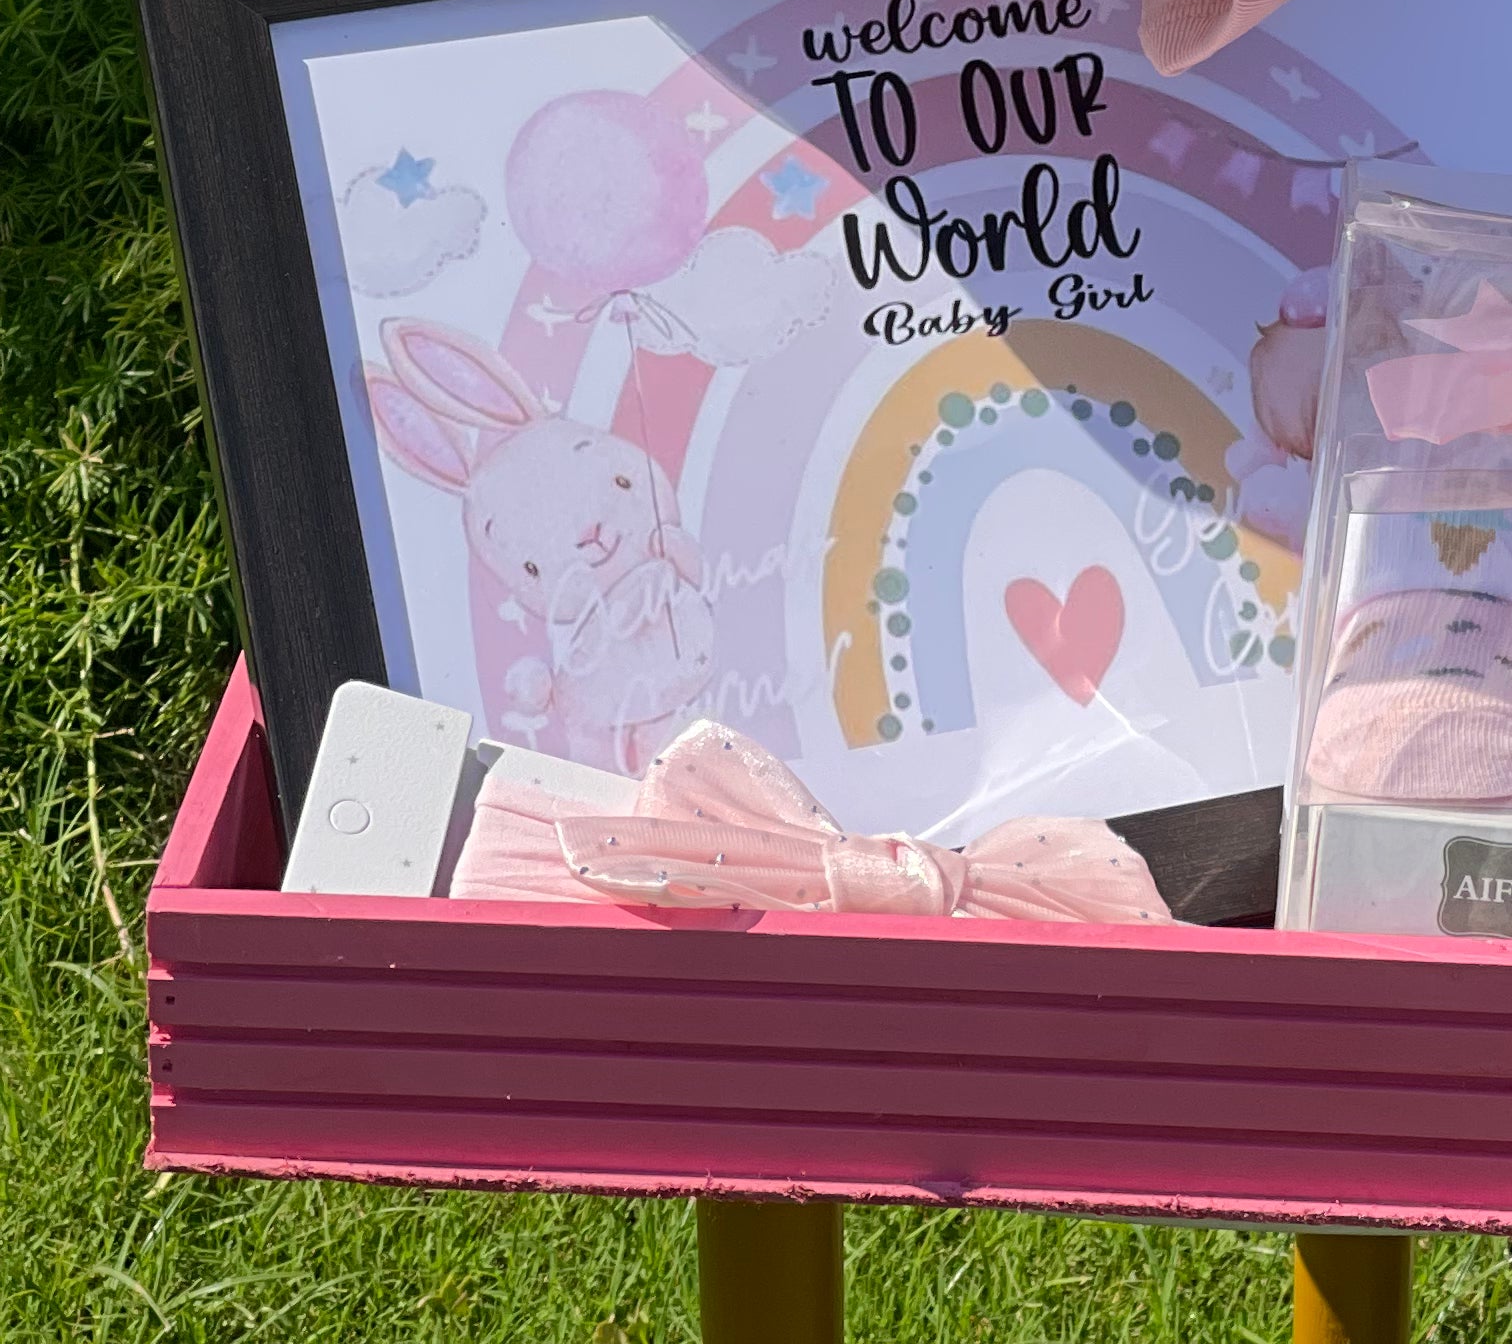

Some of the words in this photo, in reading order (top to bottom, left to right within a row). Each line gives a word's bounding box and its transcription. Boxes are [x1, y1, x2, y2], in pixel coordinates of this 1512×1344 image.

[812, 70, 918, 173] TO
[960, 52, 1108, 155] OUR
[842, 153, 1142, 290] World
[863, 300, 1022, 346] Baby
[1047, 273, 1154, 320] Girl
